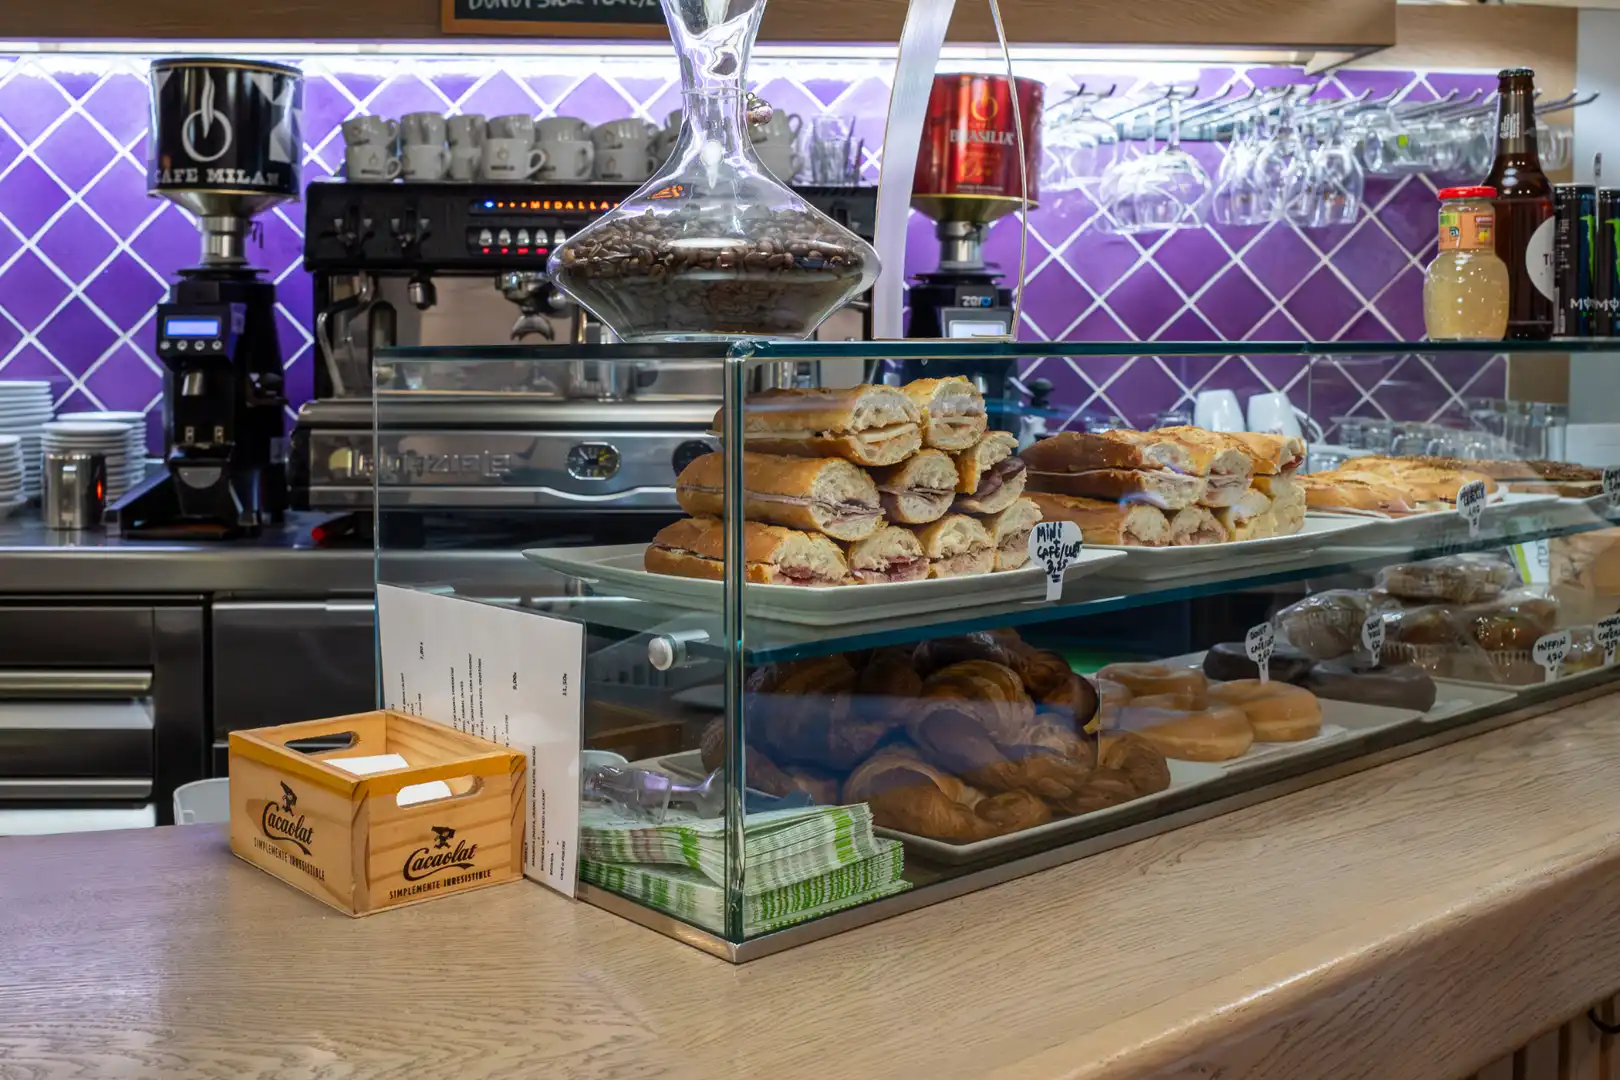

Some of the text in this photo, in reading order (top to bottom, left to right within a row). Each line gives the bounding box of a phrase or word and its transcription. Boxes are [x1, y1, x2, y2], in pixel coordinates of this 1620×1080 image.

[529, 200, 610, 210] MEDALLA
[261, 800, 315, 854] Cacaolat
[253, 836, 288, 864] SIMPLEMENTE
[402, 839, 478, 882] Cacaolat
[389, 868, 492, 899] SIMPLEMENTE IRRESISTIBLE
